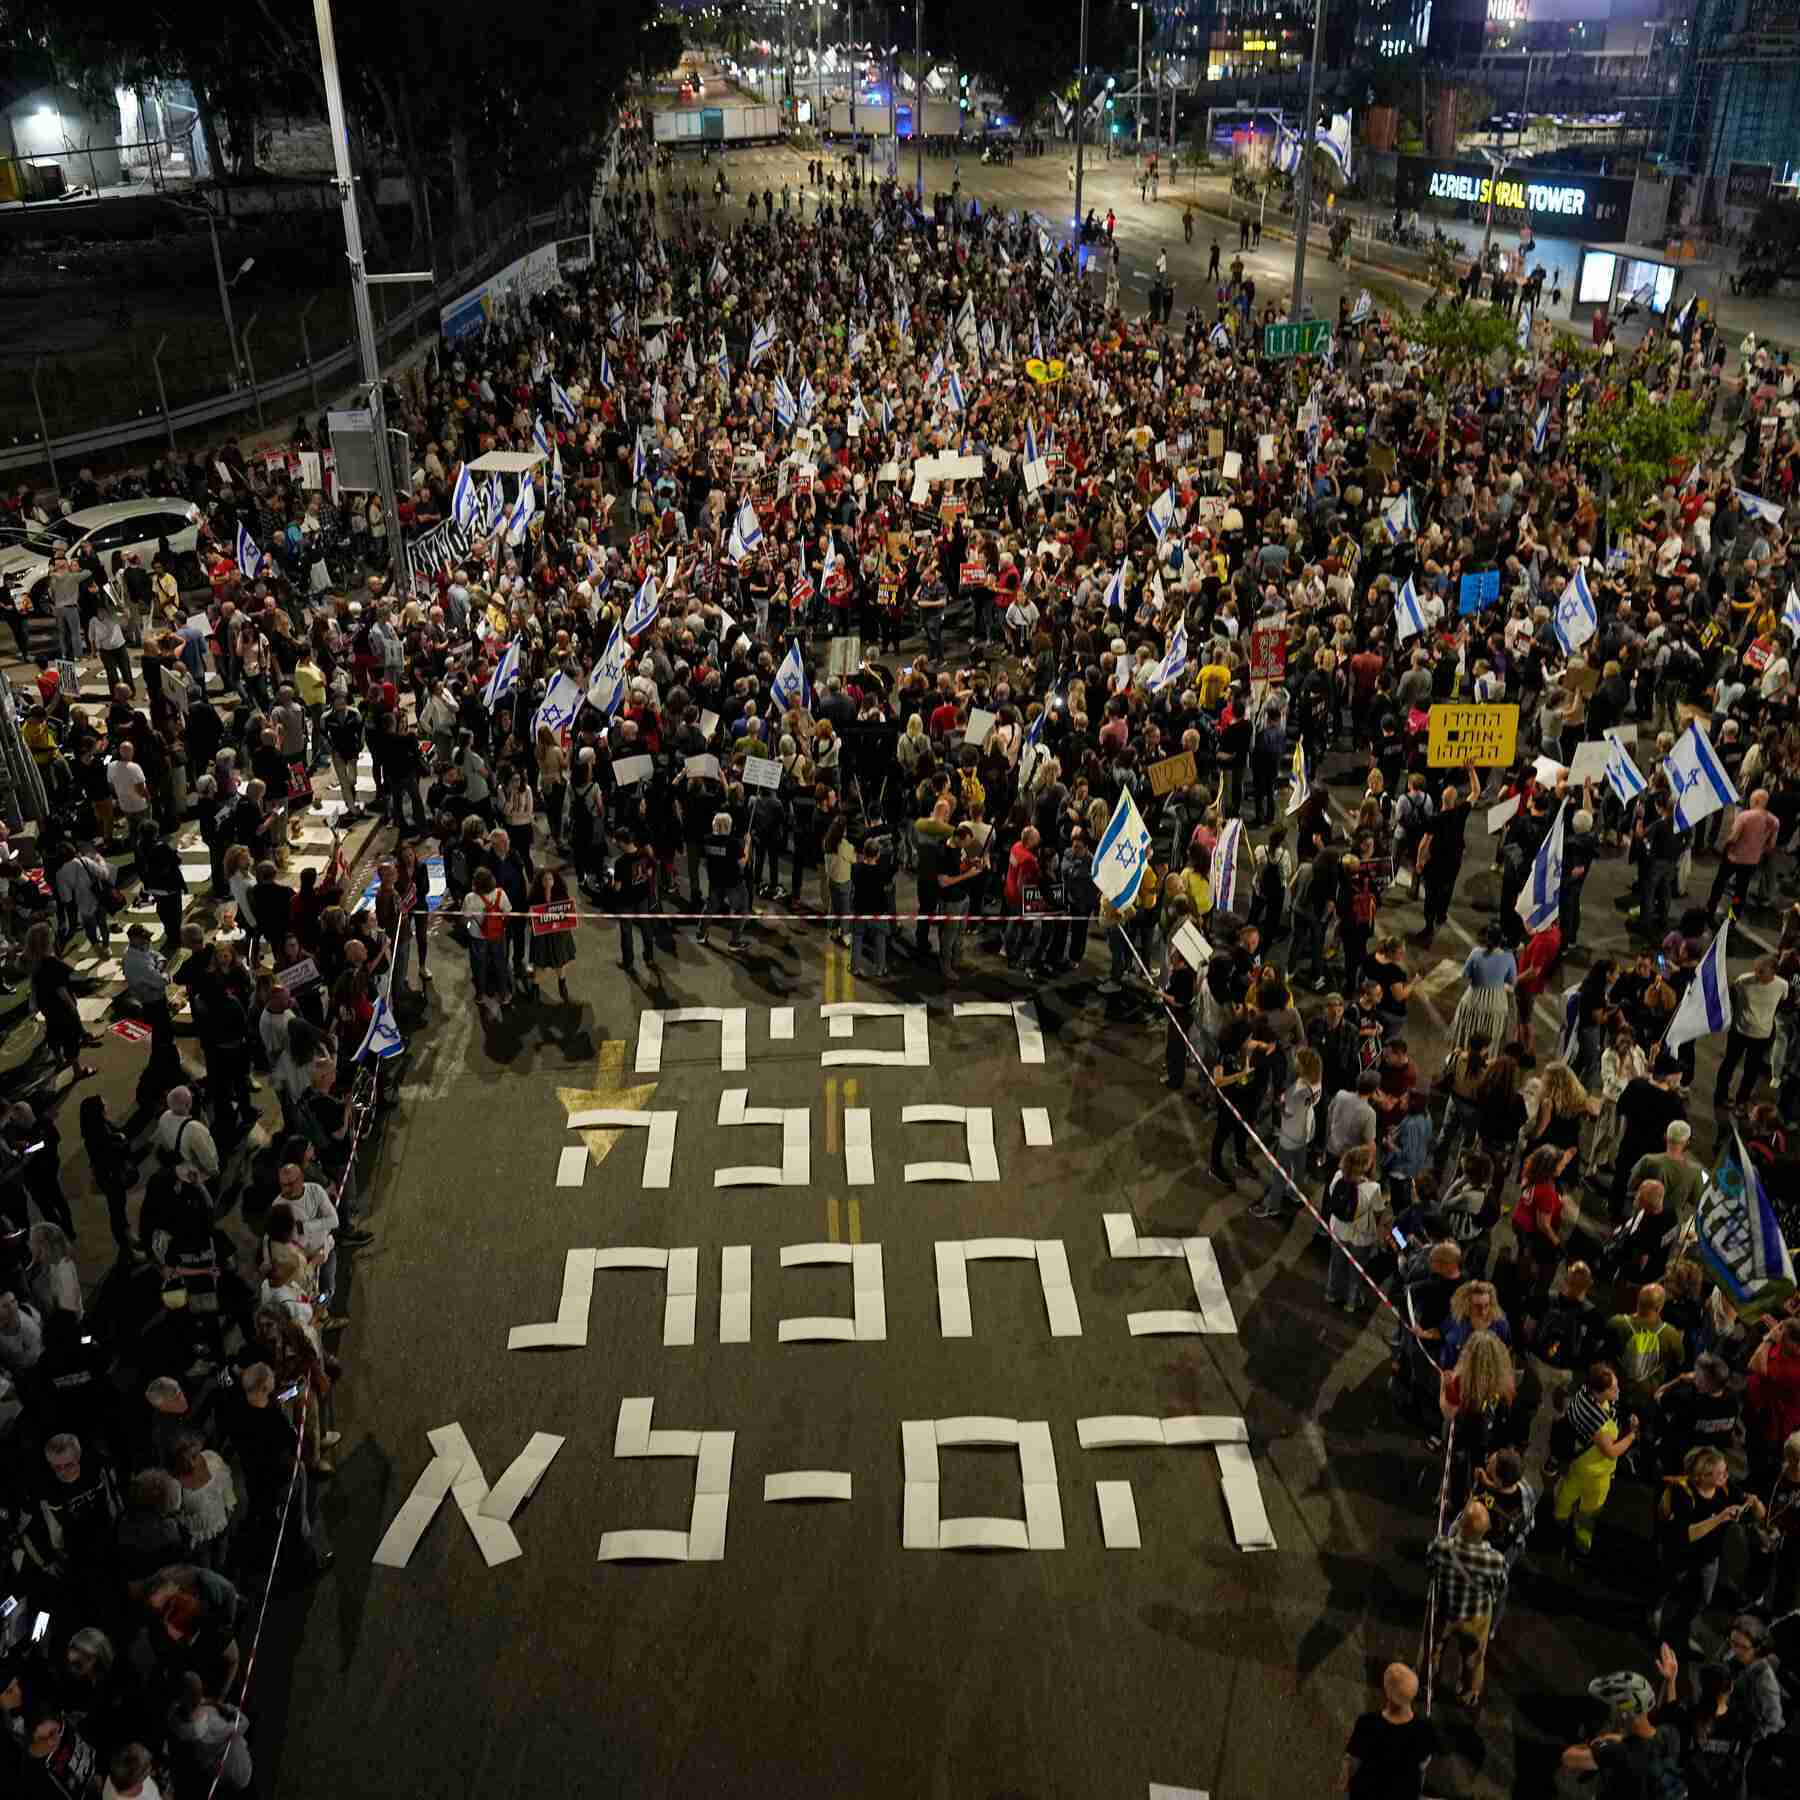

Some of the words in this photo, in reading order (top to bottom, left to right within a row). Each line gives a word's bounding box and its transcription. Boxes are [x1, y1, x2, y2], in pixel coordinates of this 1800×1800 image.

[1429, 172, 1480, 200] AZRIELI
[1527, 184, 1586, 216] TOWER
[634, 1001, 1046, 1073] רפיח
[555, 1087, 1053, 1189] יכולה
[507, 1213, 1238, 1350] לחכות
